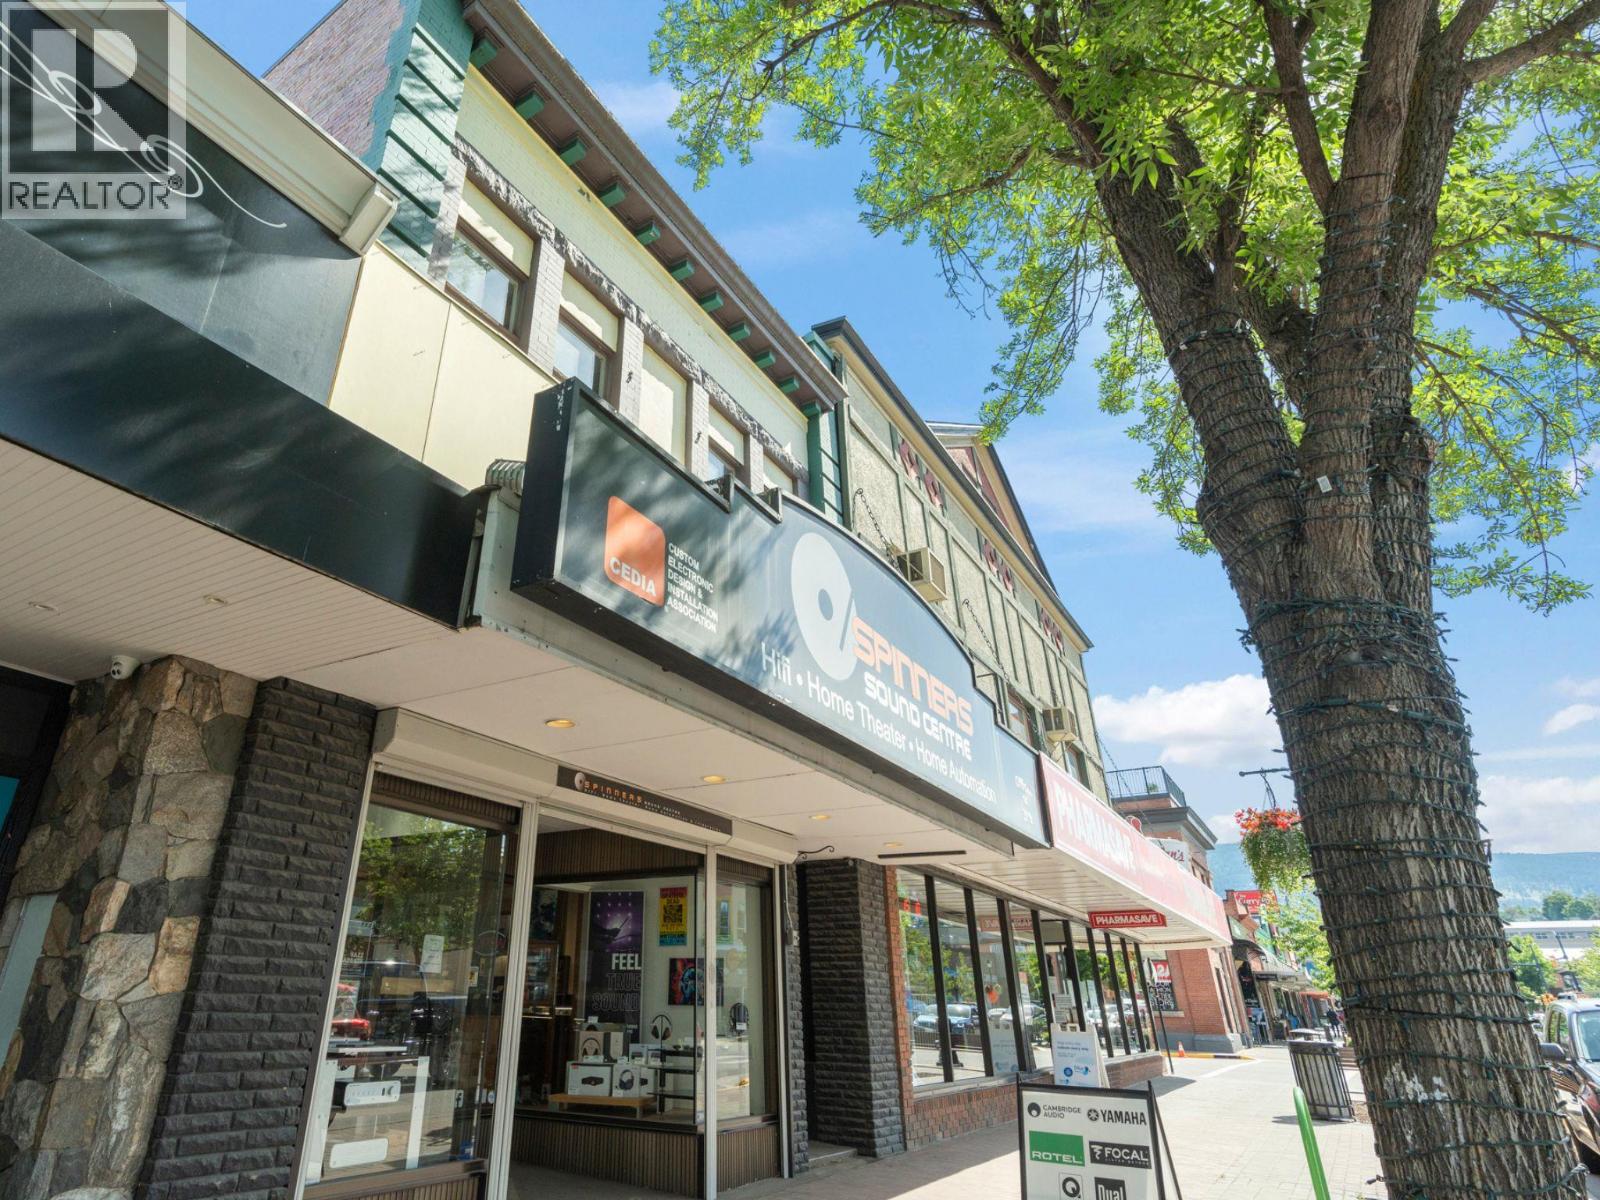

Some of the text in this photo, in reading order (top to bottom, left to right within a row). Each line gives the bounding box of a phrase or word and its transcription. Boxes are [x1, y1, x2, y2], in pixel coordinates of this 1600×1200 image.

[668, 543, 700, 571] CUSTOM
[609, 557, 657, 597] CEDIA
[668, 556, 714, 593] ELECTRONIC
[668, 569, 696, 593] DESIGN
[666, 597, 717, 633] ASSOCIATION
[667, 583, 719, 623] INSTALLATION
[852, 616, 974, 737] SPINNERS
[761, 641, 792, 687] Hifi
[808, 671, 855, 721] Home
[857, 704, 907, 751] Theater
[916, 739, 948, 777] Home
[949, 760, 998, 803] Automation
[864, 671, 972, 761] SOUND CENTRE
[1095, 914, 1159, 926] PHARMASAVE
[611, 952, 642, 970] FEEL
[1042, 1104, 1082, 1114] CAMBRIDGE
[1100, 1110, 1147, 1126] YAMAHA
[1031, 1151, 1081, 1164] ROTEL
[1104, 1147, 1148, 1162] FOCAL
